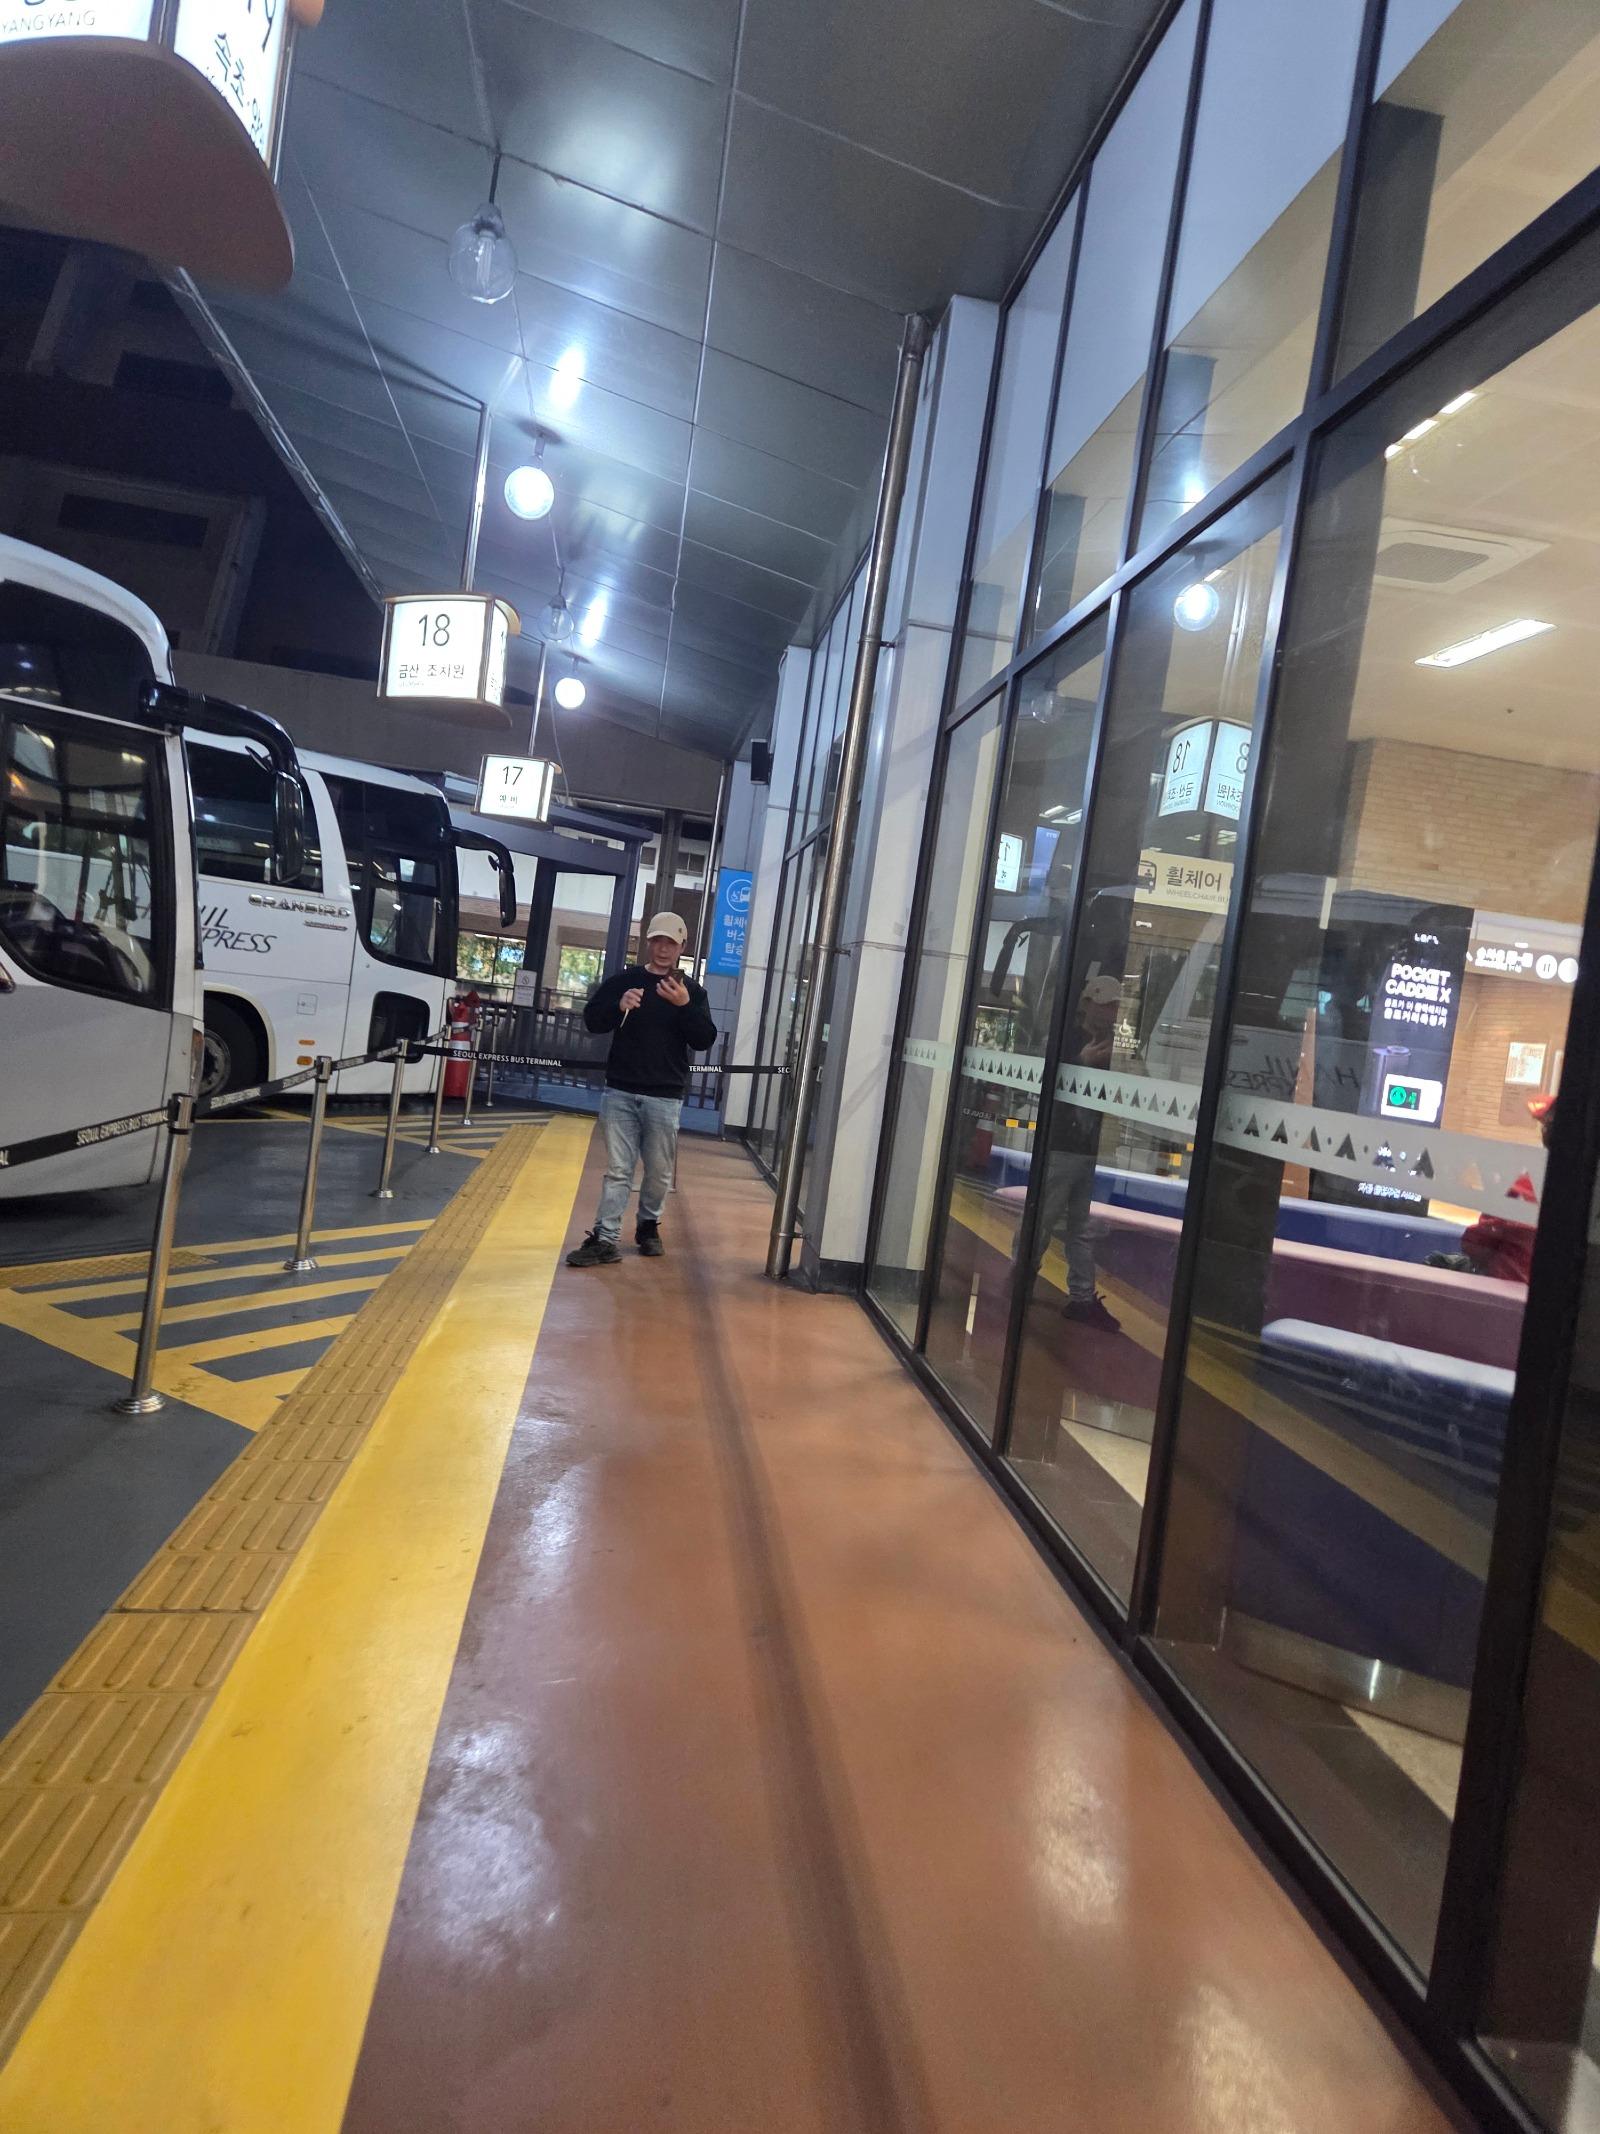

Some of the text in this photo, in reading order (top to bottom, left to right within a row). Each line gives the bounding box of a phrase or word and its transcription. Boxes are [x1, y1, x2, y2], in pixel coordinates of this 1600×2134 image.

[1, 10, 96, 33] YANGYANG
[418, 613, 450, 647] 18
[399, 663, 465, 680] 금산 조치원
[503, 765, 524, 786] 17
[1166, 864, 1222, 892] 휠체어
[727, 930, 746, 941] 버스
[1391, 963, 1451, 986] POCKET
[1385, 979, 1452, 1004] CADDIE X
[453, 1049, 562, 1067] SEOUL EXPRESS BUS TERMINAL
[688, 1065, 723, 1073] TERMINAL
